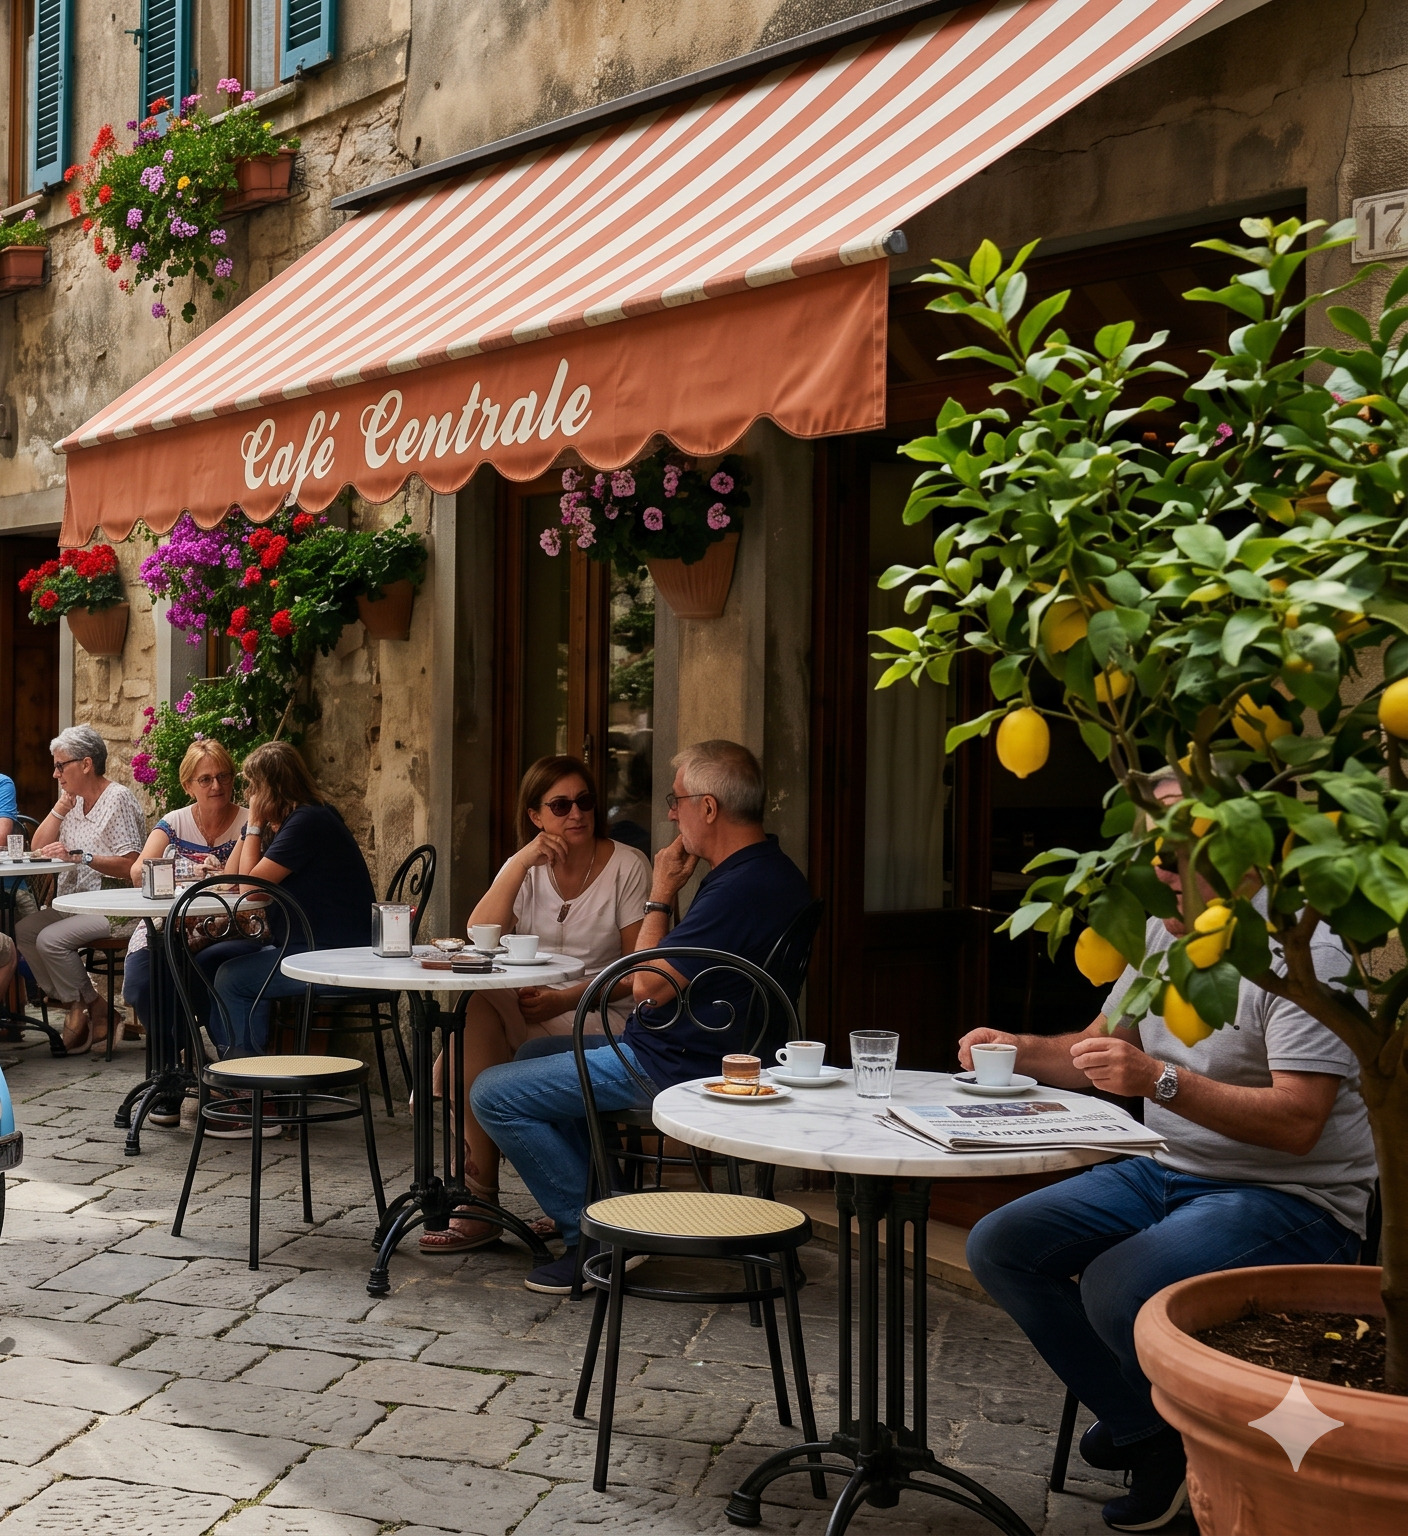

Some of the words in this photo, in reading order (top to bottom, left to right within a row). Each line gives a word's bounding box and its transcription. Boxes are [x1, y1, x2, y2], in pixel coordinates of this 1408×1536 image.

[1365, 201, 1407, 250] 17
[240, 410, 341, 507] Café
[359, 357, 593, 470] Centrale
